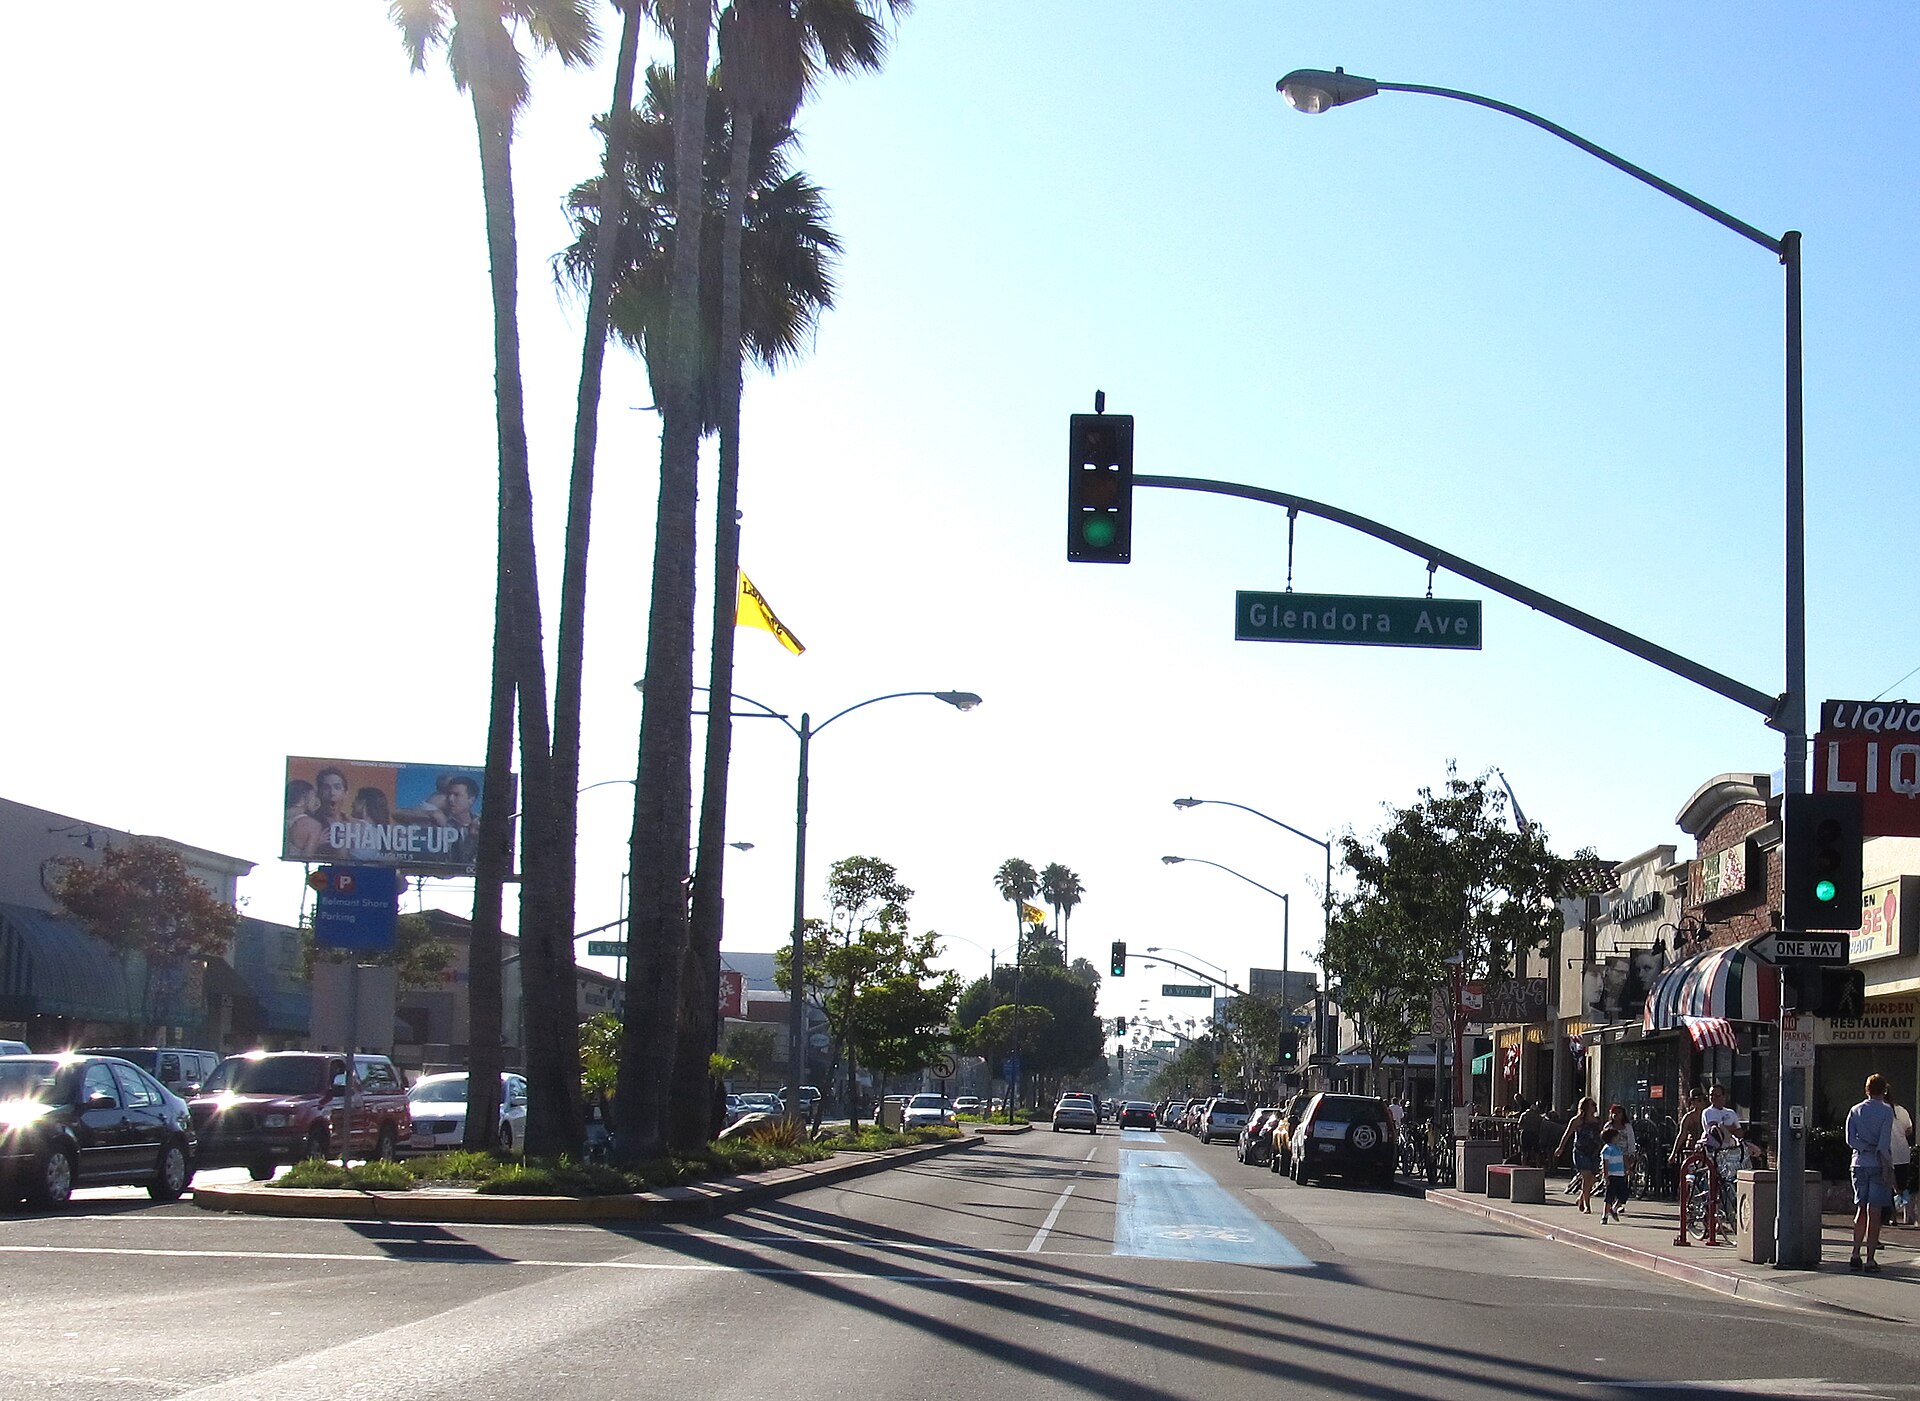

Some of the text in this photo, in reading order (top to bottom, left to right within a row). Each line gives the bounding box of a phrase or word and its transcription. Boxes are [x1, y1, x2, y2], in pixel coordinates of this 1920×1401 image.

[1250, 603, 1468, 635] Glendora Ave
[330, 821, 460, 853] CHANGE-UP
[340, 875, 352, 889] P
[321, 896, 389, 908] Belmont Shore
[321, 911, 356, 923] Parking
[1776, 942, 1805, 956] ONE
[1810, 942, 1838, 956] WAY
[1830, 1017, 1915, 1028] RESTAURANT
[1784, 1031, 1812, 1042] PARKING
[1832, 1031, 1910, 1040] FOOD TO GO
